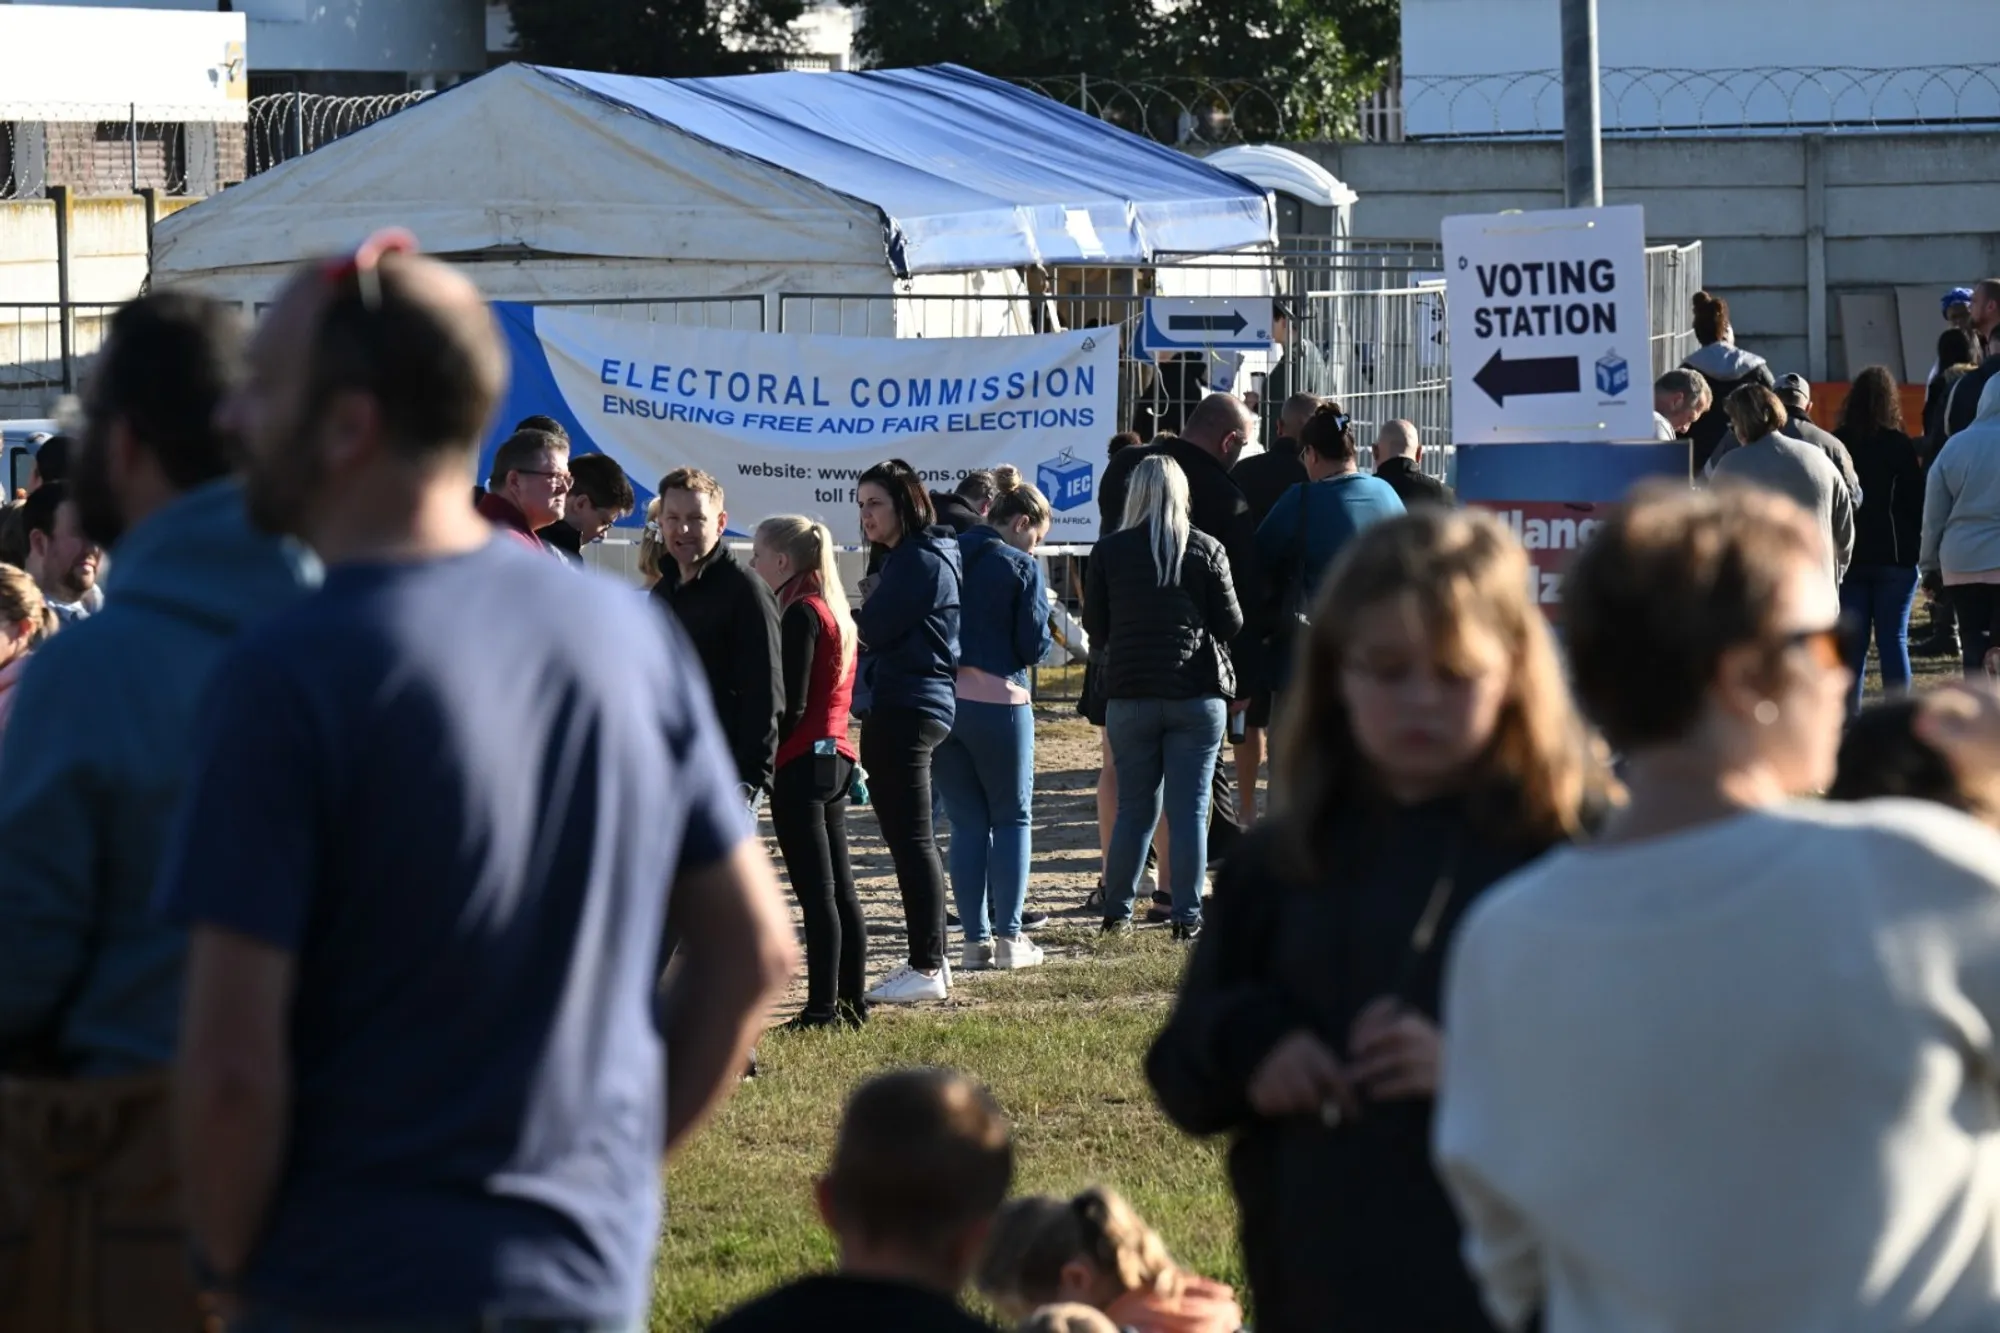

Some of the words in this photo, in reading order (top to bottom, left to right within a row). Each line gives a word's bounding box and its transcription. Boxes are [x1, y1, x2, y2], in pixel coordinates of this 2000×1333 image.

[1475, 258, 1616, 298] VOTING
[1474, 302, 1617, 339] STATION
[600, 358, 830, 407] ELECTORAL
[850, 365, 1095, 408] COMMISSION
[602, 394, 735, 426] ENSURING
[742, 413, 814, 433] FREE
[817, 416, 875, 434] AND
[881, 415, 939, 433] FAIR
[947, 407, 1094, 432] ELECTIONS
[737, 462, 812, 480] website:
[1067, 475, 1091, 498] IEC
[814, 488, 843, 503] toll
